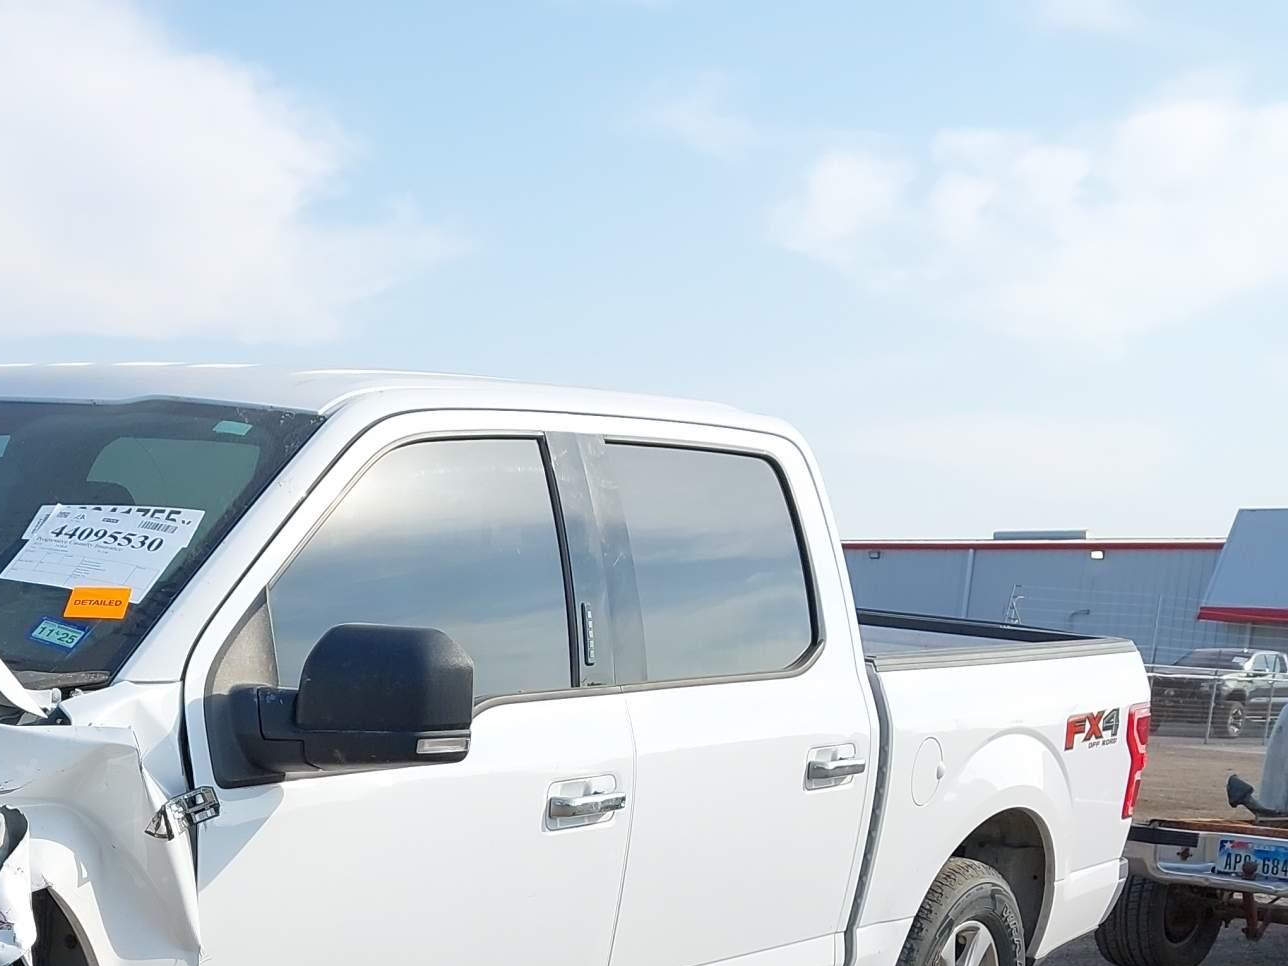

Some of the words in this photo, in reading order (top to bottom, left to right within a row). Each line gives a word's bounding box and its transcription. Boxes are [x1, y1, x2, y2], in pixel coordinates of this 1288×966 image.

[51, 524, 164, 552] 44095530
[73, 599, 123, 607] DETAILED
[1064, 707, 1120, 751] FX4
